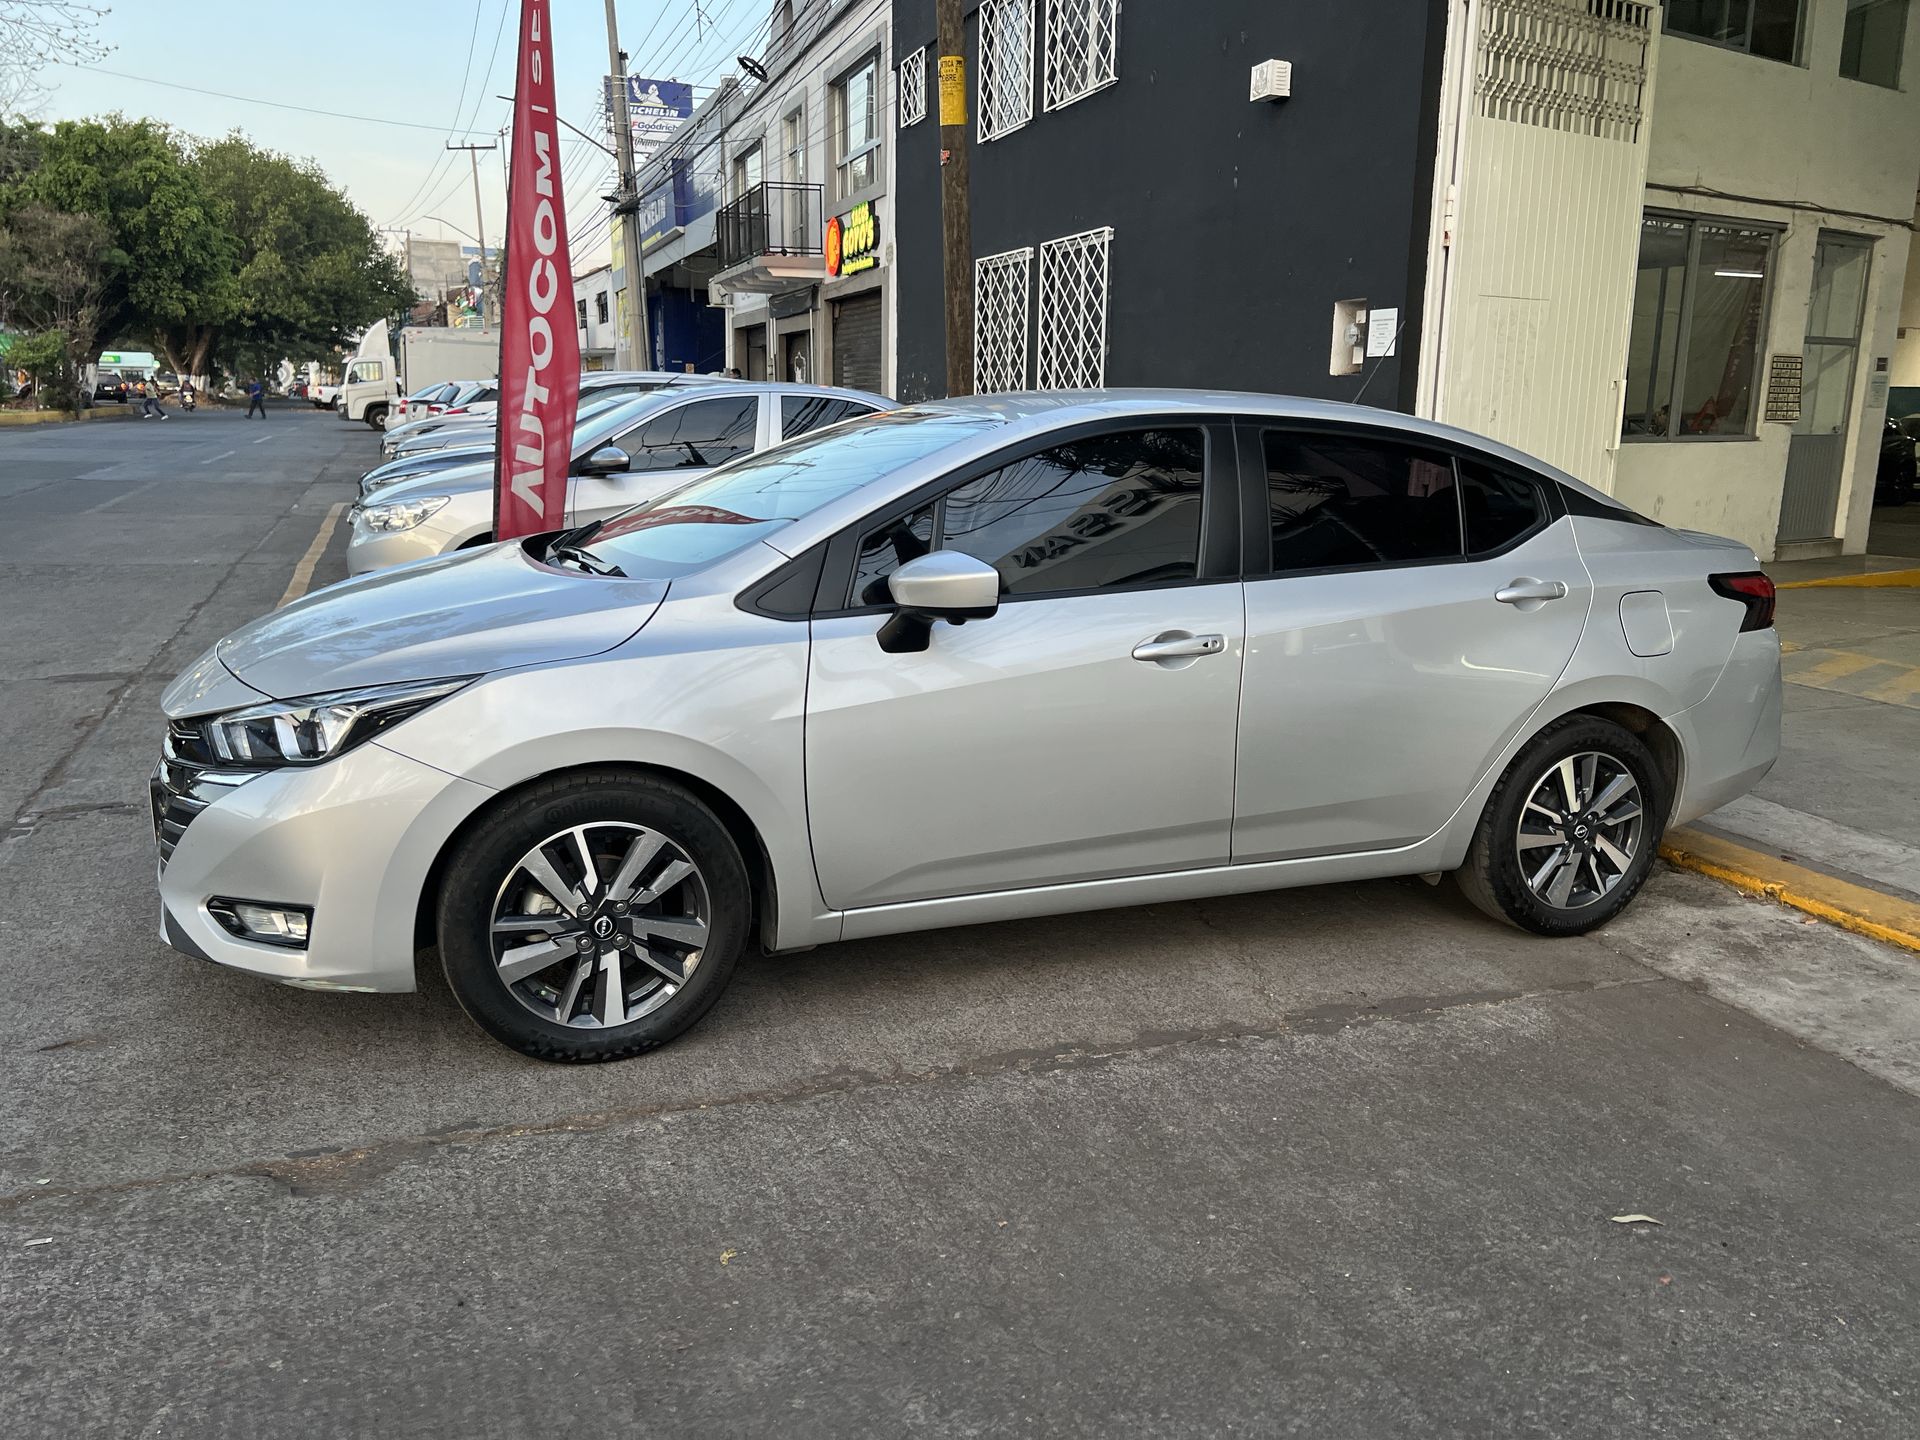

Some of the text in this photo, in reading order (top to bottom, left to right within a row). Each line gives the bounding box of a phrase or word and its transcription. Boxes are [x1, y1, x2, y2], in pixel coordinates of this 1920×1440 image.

[631, 121, 678, 132] FGoodrich
[843, 214, 874, 259] GOYO'S
[511, 130, 558, 519] AUTOCOM
